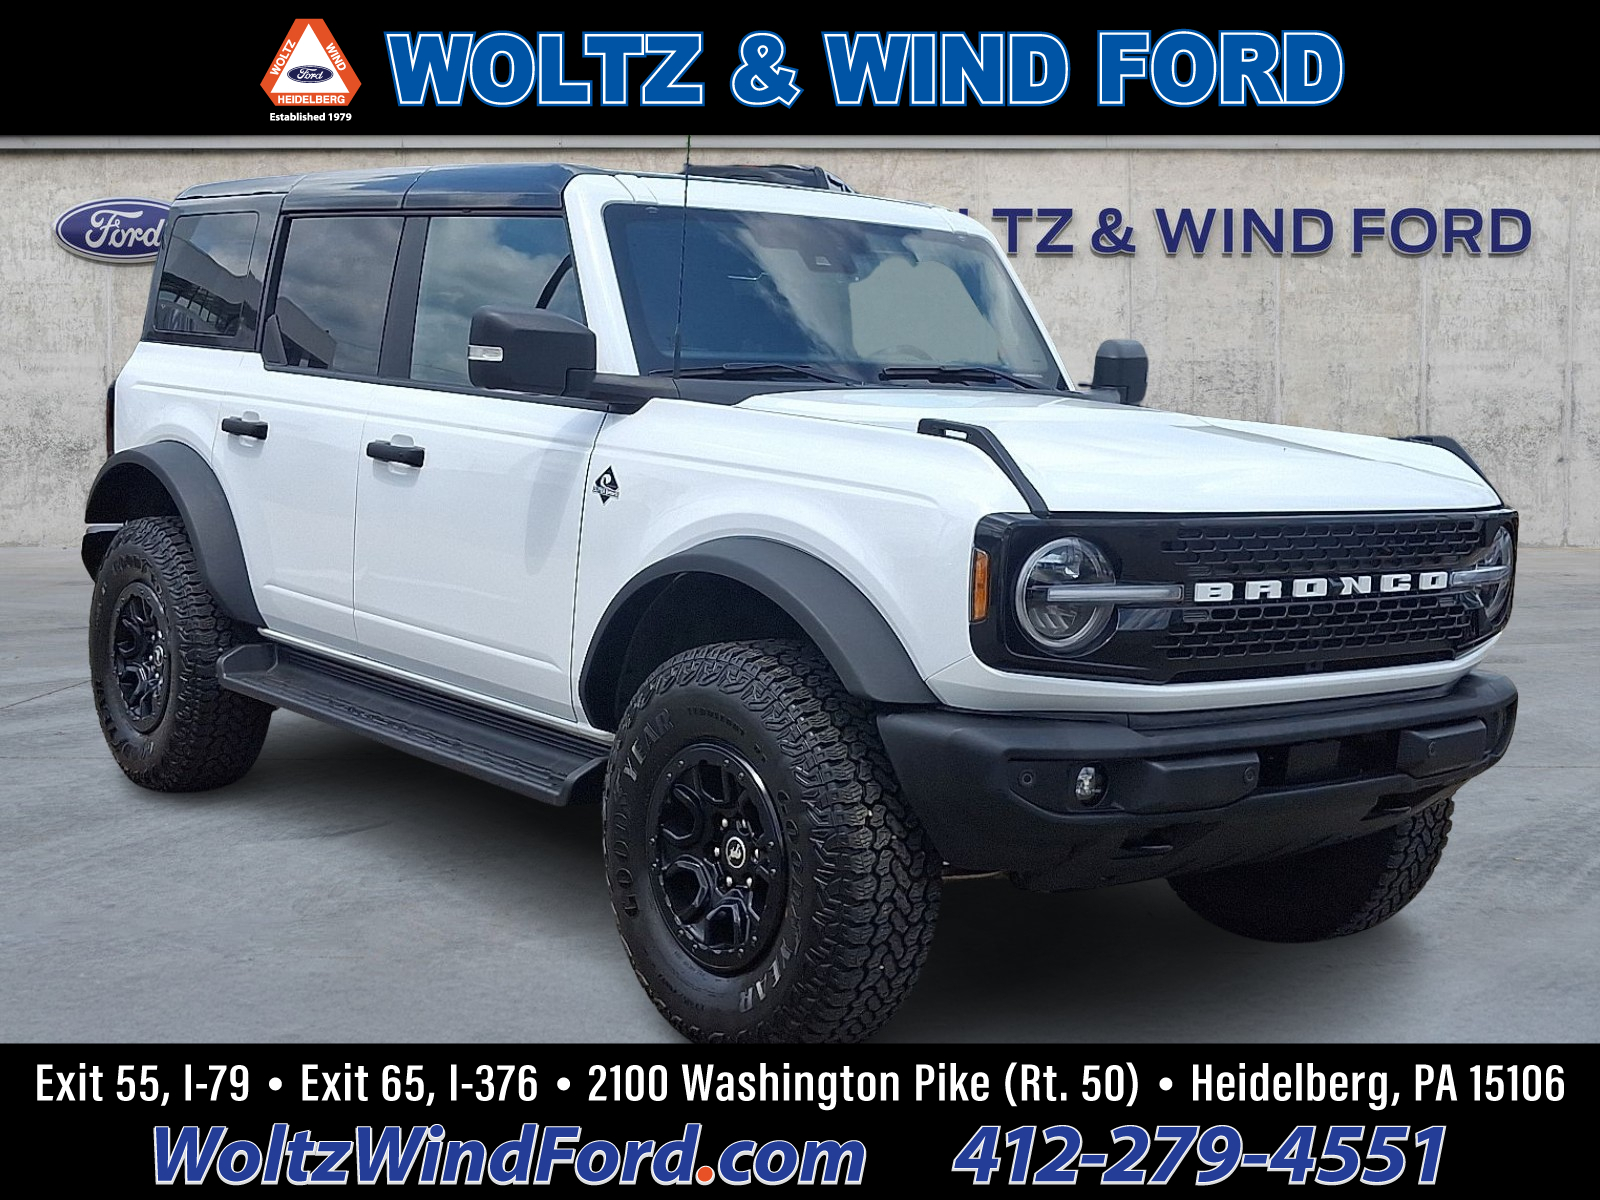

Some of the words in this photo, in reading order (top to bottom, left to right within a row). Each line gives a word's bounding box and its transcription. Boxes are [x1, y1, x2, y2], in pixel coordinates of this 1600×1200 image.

[84, 209, 166, 249] Ford
[1091, 207, 1136, 255] &
[1154, 207, 1334, 255] WIND
[1352, 207, 1532, 255] FORD
[1194, 571, 1449, 602] BRONCO
